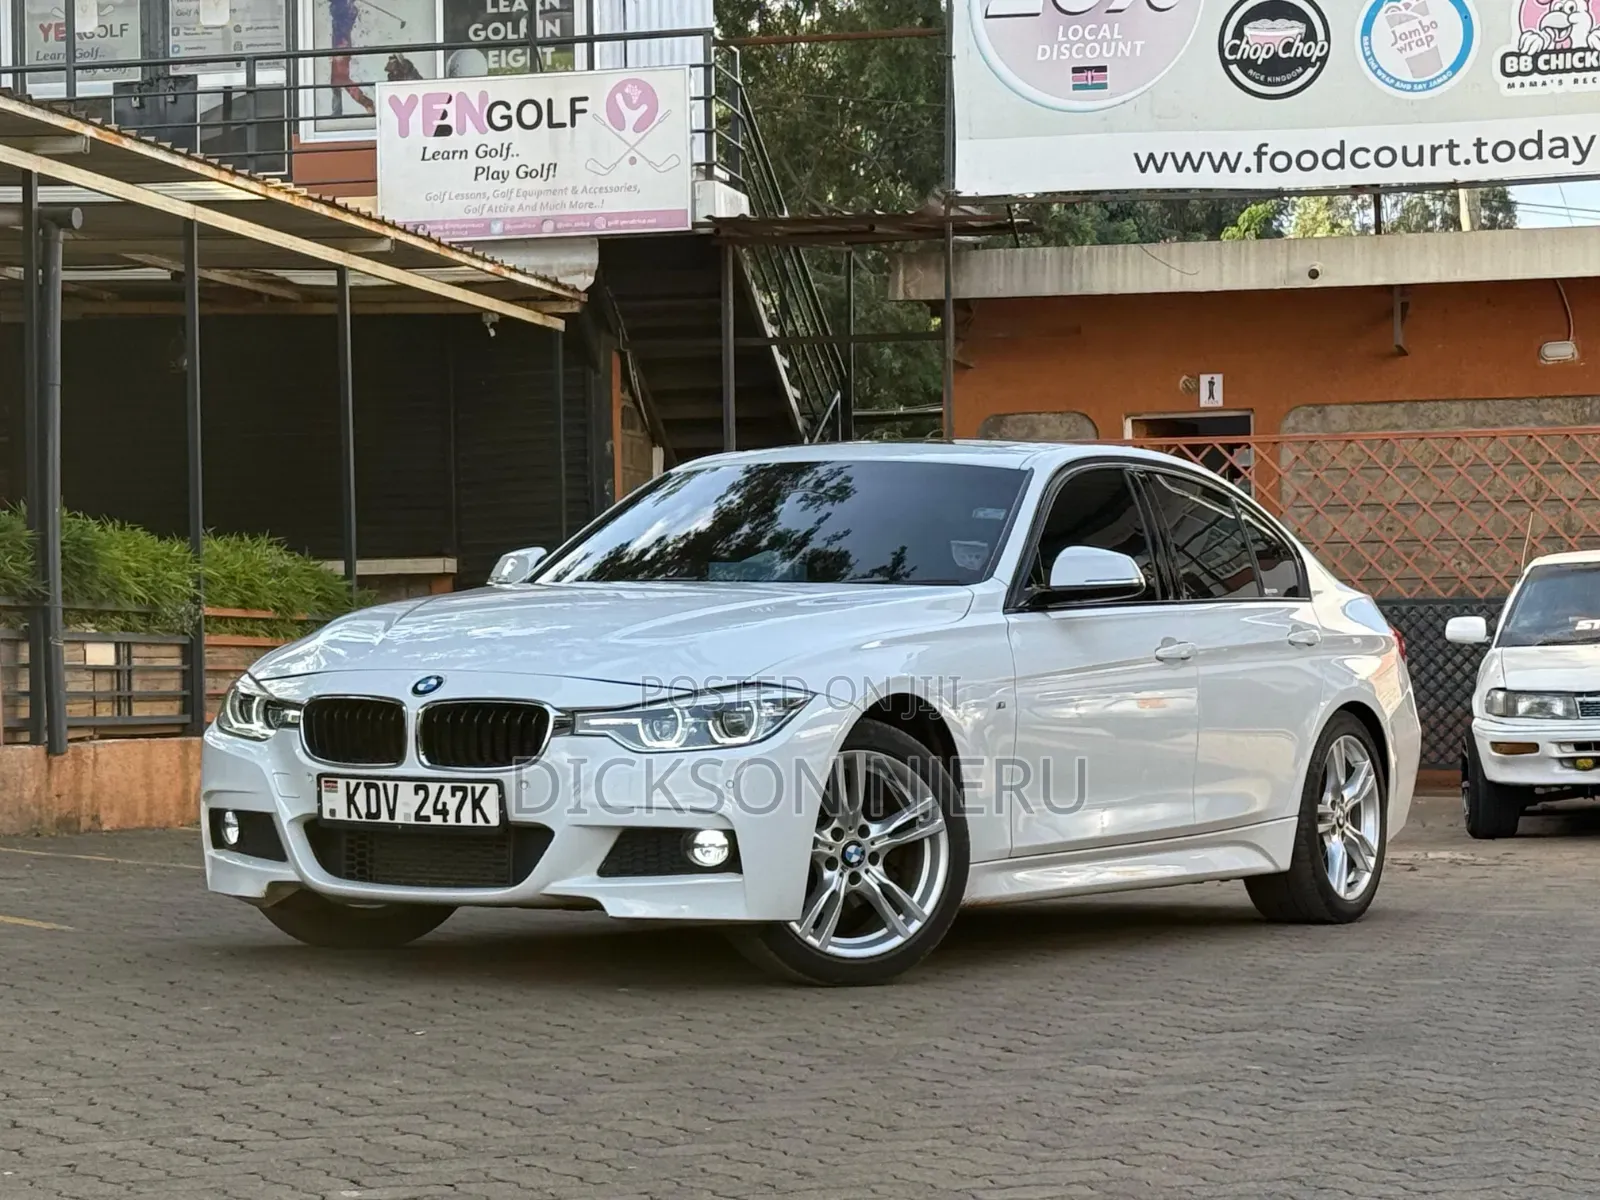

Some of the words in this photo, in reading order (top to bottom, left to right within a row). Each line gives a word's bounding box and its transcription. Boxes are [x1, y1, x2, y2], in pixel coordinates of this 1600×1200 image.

[486, 0, 560, 13] LEAN
[1057, 23, 1123, 41] LOCAL
[1391, 20, 1438, 47] Jambo
[1037, 41, 1145, 61] DISCOUNT
[1224, 35, 1275, 65] Chop
[1278, 34, 1329, 62] Chop
[1396, 34, 1435, 54] wrap
[1504, 55, 1533, 73] BB
[1537, 51, 1600, 71] CHICK
[1247, 68, 1266, 81] RICE
[1267, 66, 1304, 83] KINGDOM
[421, 146, 469, 161] Learn
[1134, 130, 1597, 174] www.foodcourt.today
[474, 165, 510, 184] Play
[516, 162, 558, 182] Golf!
[425, 191, 448, 204] Golf
[449, 190, 490, 203] Lessons,
[492, 188, 514, 201] Golf
[516, 186, 568, 200] Equipment
[570, 185, 579, 195] &
[581, 182, 641, 196] Accessories,
[464, 203, 486, 216] Golf
[486, 202, 516, 214] Attire
[517, 200, 538, 213] And
[540, 200, 567, 212] Much
[346, 780, 399, 821] KDV
[413, 783, 491, 825] 247K
